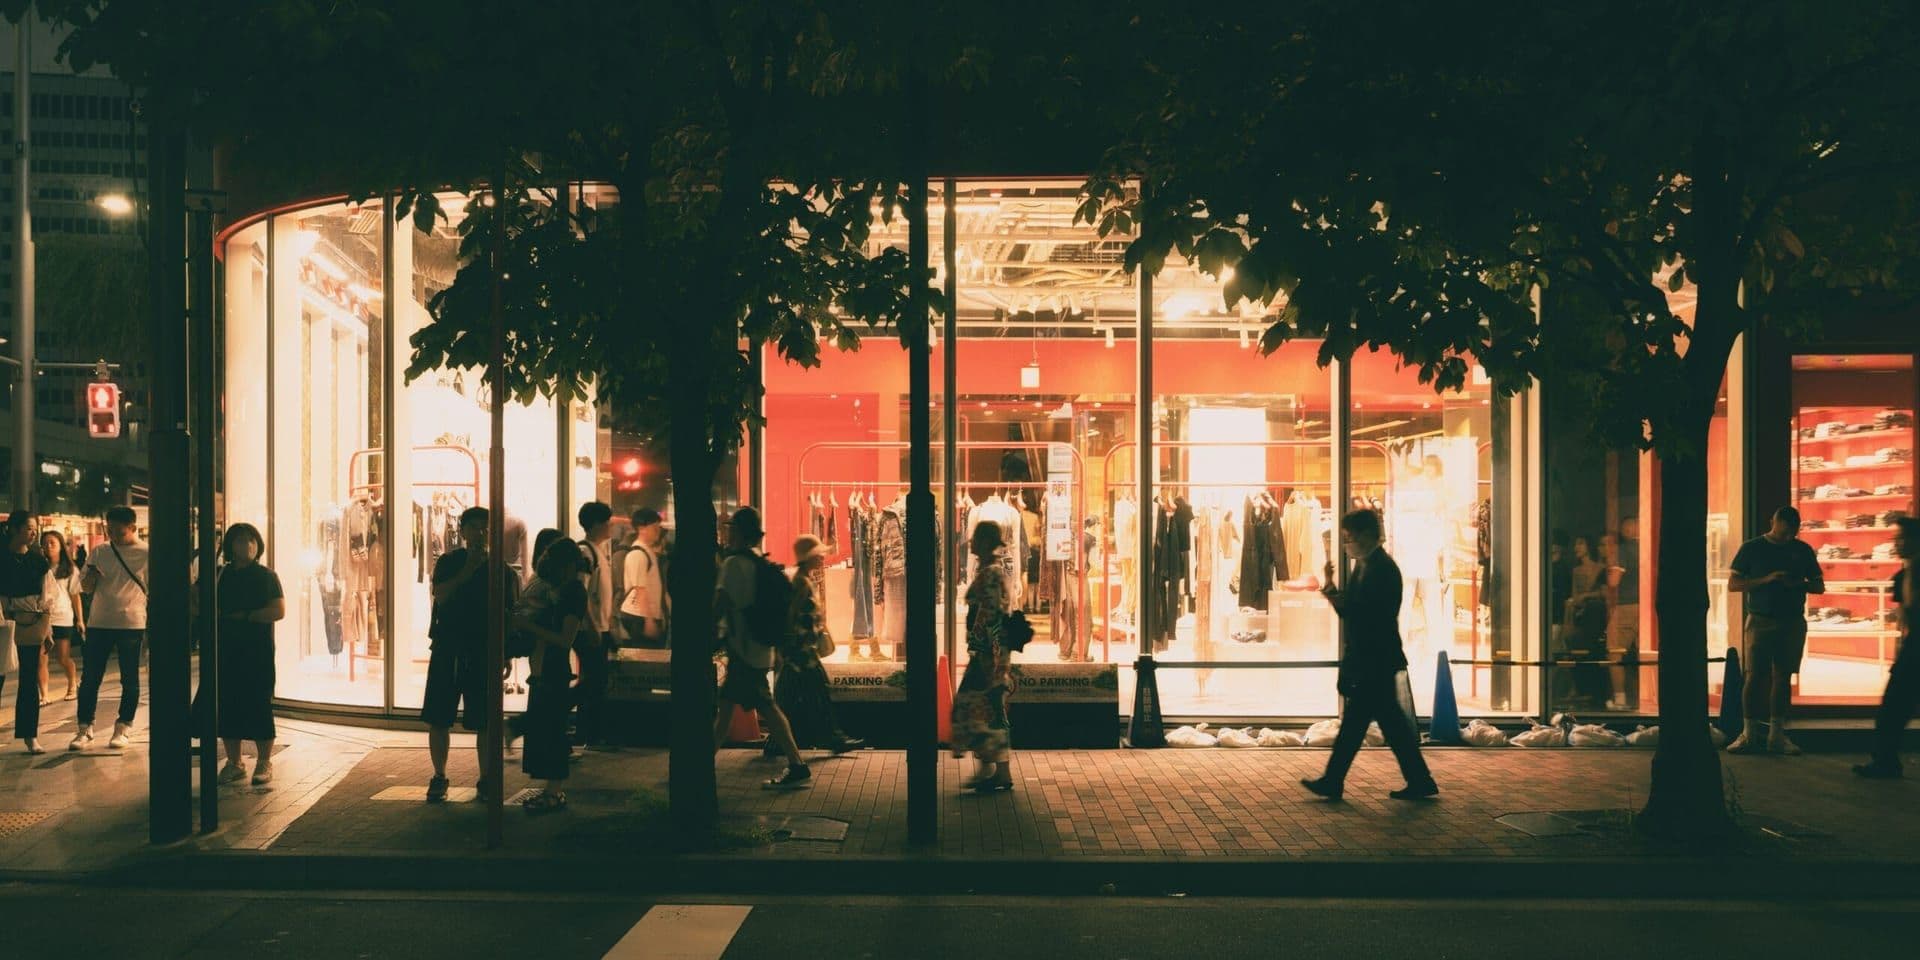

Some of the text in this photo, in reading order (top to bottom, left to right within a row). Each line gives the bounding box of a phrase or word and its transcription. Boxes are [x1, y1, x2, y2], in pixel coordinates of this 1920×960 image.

[834, 676, 883, 686] PARKING
[1018, 677, 1090, 688] NO PARKING
